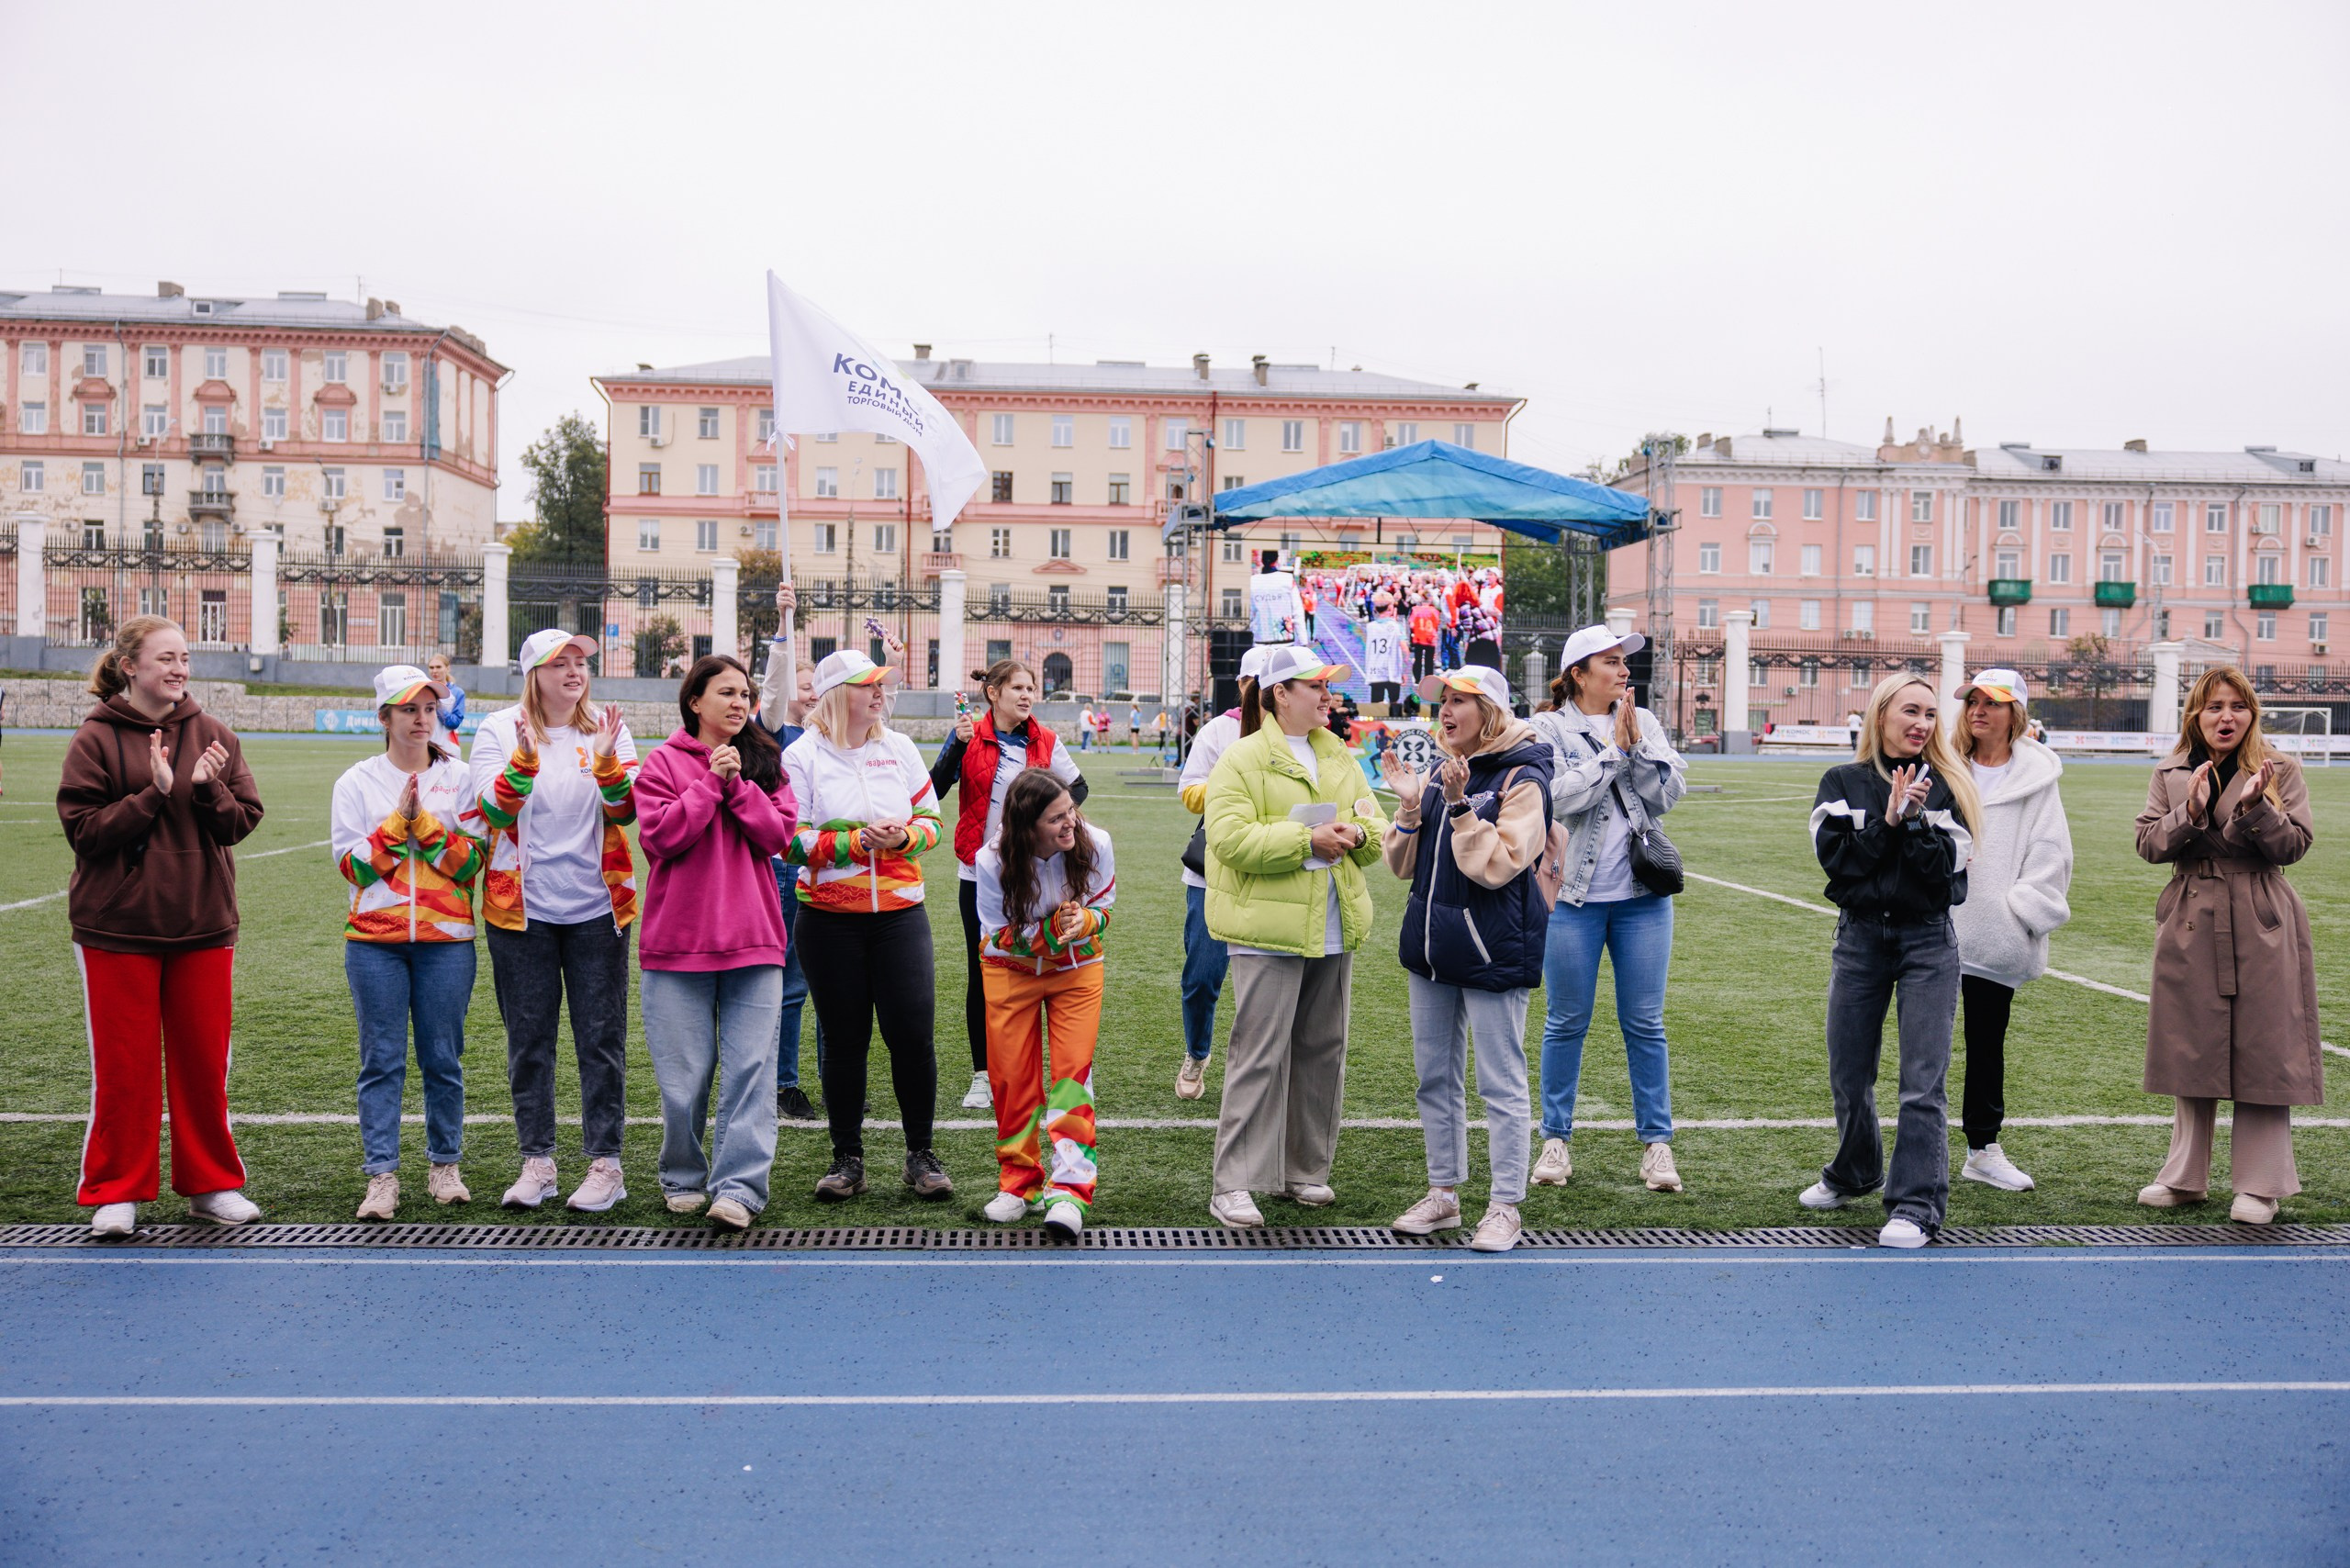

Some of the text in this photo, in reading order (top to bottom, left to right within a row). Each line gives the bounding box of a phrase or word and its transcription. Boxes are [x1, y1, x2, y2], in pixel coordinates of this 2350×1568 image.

[847, 396, 923, 437] ТОРГОВЫЙ ДОМ
[1371, 638, 1388, 655] 13
[345, 715, 380, 728] Дина
